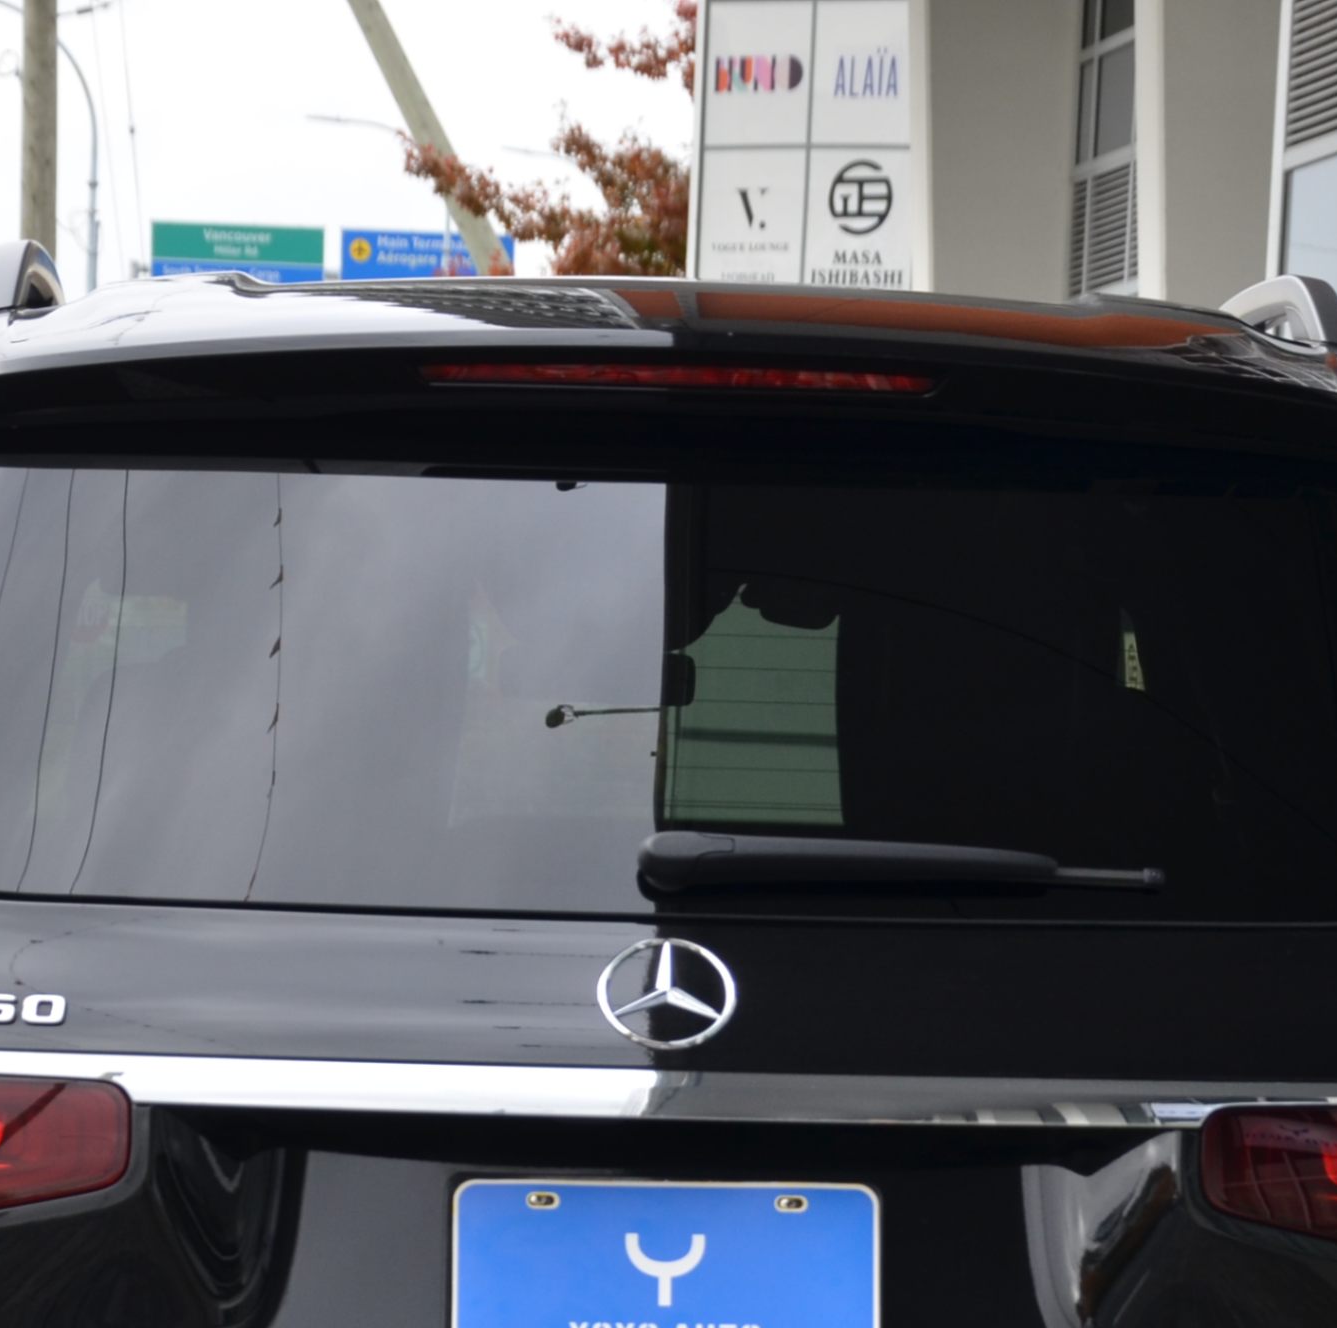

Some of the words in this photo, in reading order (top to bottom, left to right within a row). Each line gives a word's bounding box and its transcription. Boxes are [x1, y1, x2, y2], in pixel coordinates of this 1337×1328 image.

[834, 47, 899, 99] ALAÏA
[202, 227, 273, 244] Vancouver
[376, 234, 409, 249] Main
[832, 250, 883, 265] MASA
[810, 268, 904, 287] ISHIBASHI
